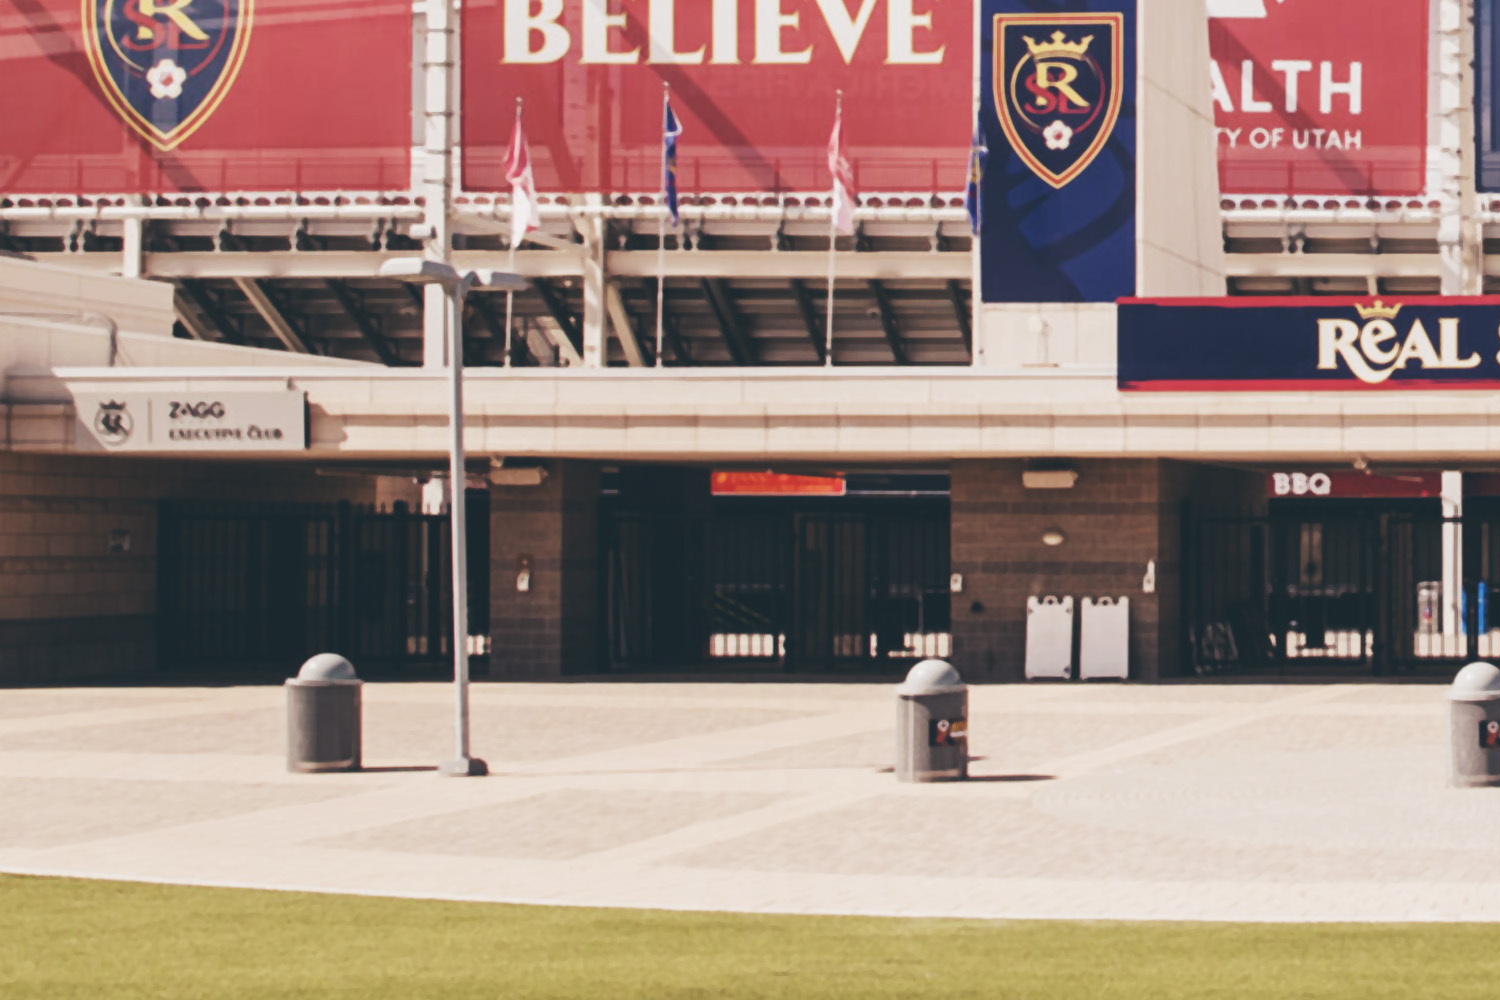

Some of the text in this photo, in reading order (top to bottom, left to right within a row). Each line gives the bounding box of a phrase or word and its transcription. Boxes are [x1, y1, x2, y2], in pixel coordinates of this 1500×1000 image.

[1249, 127, 1285, 149] OF
[1292, 128, 1362, 151] UTAH
[168, 401, 226, 419] ZAGG
[1272, 472, 1332, 495] BBQ
